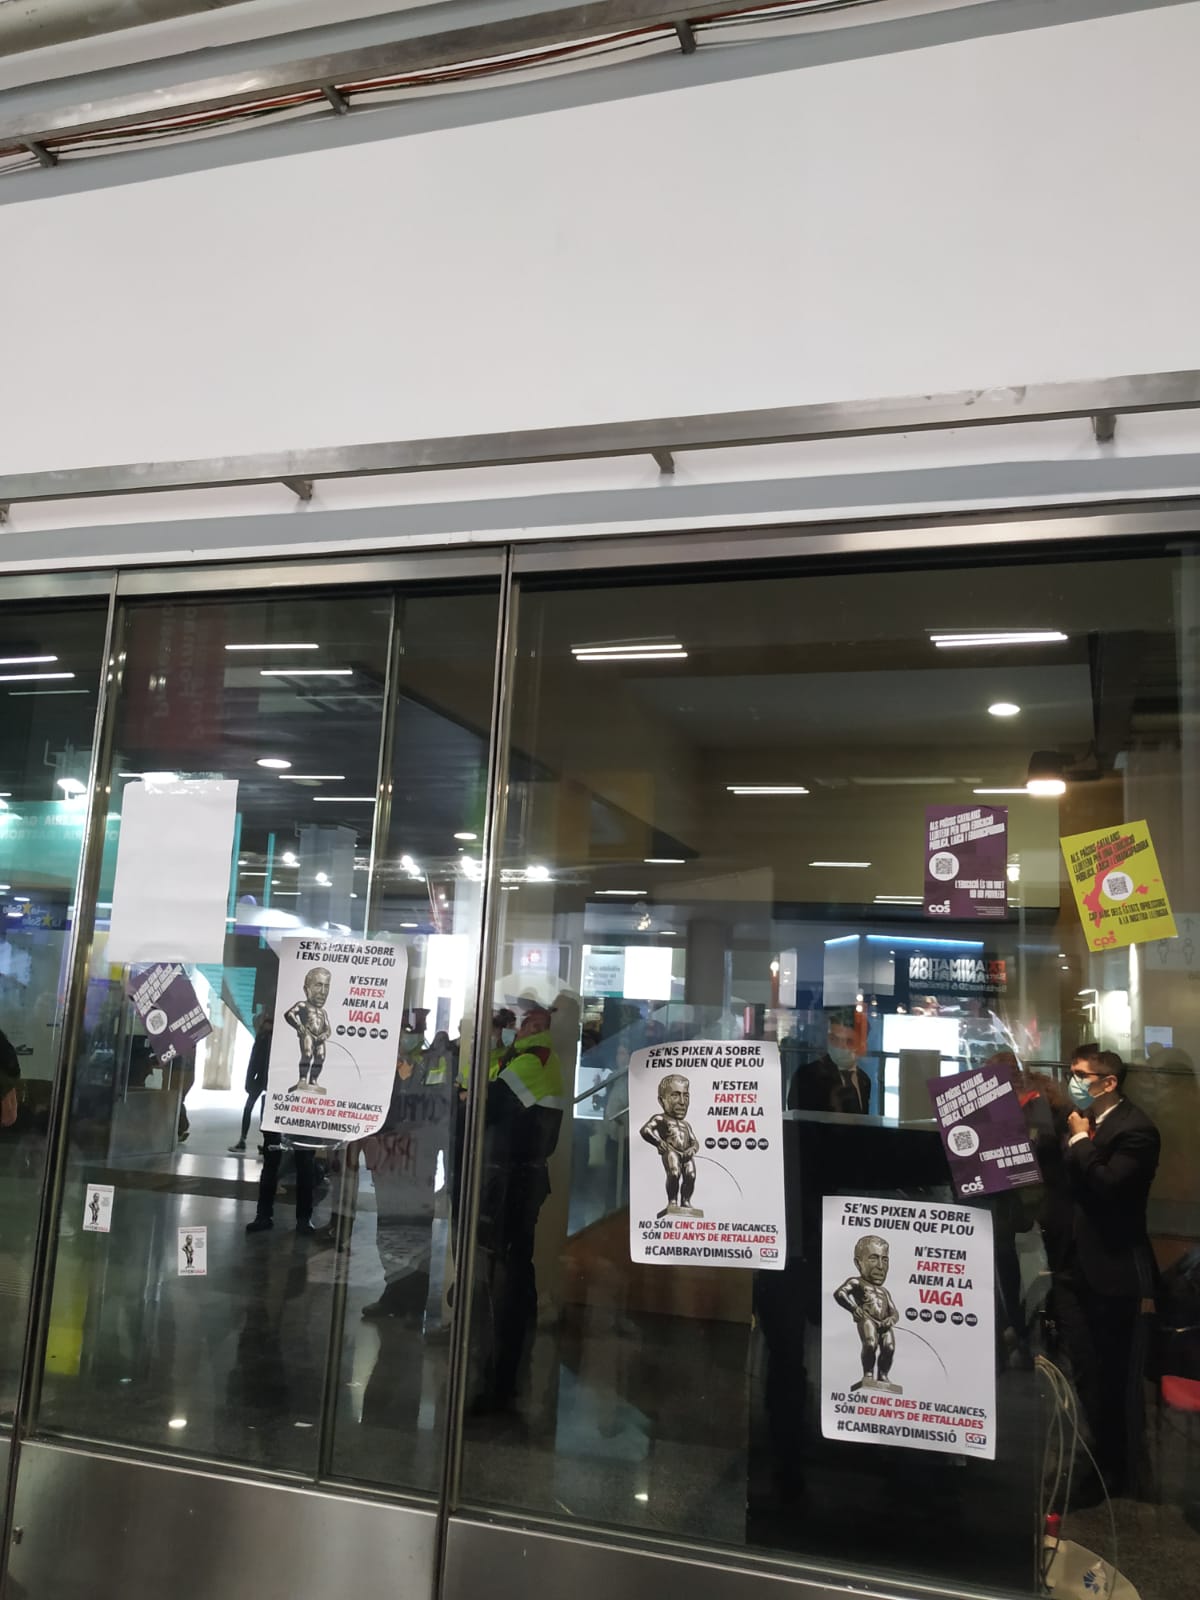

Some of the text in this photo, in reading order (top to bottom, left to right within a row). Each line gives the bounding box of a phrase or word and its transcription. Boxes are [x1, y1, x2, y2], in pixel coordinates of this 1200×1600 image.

[356, 945, 363, 954] A
[364, 946, 395, 956] SOBRE
[296, 952, 396, 967] I ENS DIUEN QUE PLOU
[349, 975, 388, 986] N'ESTEM
[349, 987, 386, 998] FARTES!
[342, 998, 389, 1010] ANEM A LA
[348, 1010, 381, 1024] VAGA
[648, 1046, 761, 1057] SE'NS PIXEN A SOBRE
[646, 1058, 764, 1069] I ENS DIUEN QUE PLOU
[712, 1080, 758, 1090] N'ESTEM
[272, 1093, 283, 1101] NO
[284, 1093, 300, 1103] SÓN
[301, 1096, 318, 1105] CINC
[319, 1098, 336, 1107] DIES
[336, 1100, 346, 1108] DE
[714, 1093, 757, 1103] FARTES!
[274, 1102, 380, 1121] SÓN DEU ANYS DE RETALLADES
[707, 1106, 764, 1116] ANEM A LA
[274, 1115, 360, 1134] #CAMBRAYDIMISSIÓ
[716, 1120, 756, 1133] VAGA
[844, 1202, 971, 1222] SE'NS PIXEN A SOBRE
[639, 1218, 778, 1234] NO SÓN CINC DIES DE VACANCES,
[841, 1216, 974, 1236] I ENS DIUEN QUE PLOU
[642, 1229, 776, 1244] SÓN DEU ANYS DE RETALLADES
[645, 1245, 752, 1259] #CAMBRAYDIMISSIÓ
[914, 1246, 967, 1260] N'ESTEM
[917, 1260, 965, 1275] FARTES!
[909, 1274, 973, 1290] ANEM A LA
[919, 1289, 963, 1307] VAGA
[831, 1392, 987, 1419] NO SÓN CINC DIES DE VACANCES,
[834, 1403, 984, 1430] SÓN DEU ANYS DE RETALLADES
[837, 1420, 987, 1445] #CAMBRAYDIMISSIÓ CGT
